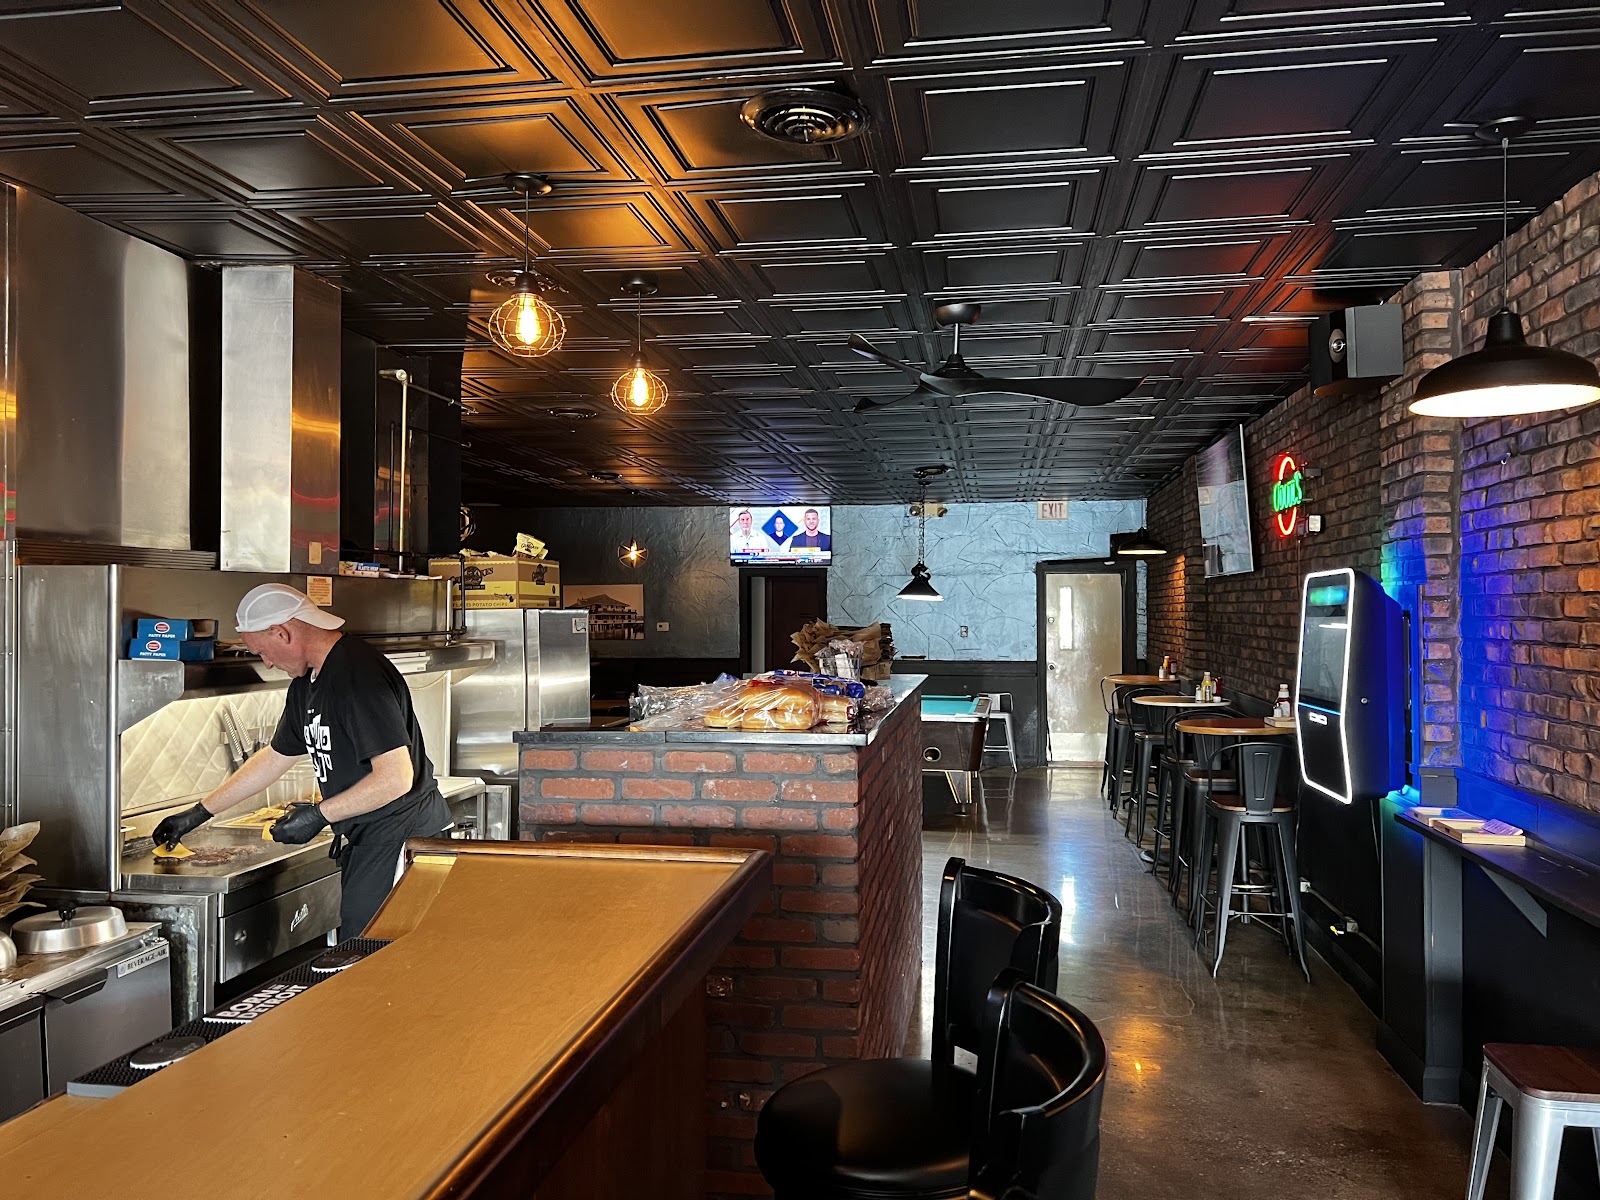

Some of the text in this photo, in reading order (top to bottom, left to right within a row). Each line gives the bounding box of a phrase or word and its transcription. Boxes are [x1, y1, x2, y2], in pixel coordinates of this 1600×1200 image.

[1041, 502, 1064, 519] EXIT
[216, 989, 281, 1018] BORN
[237, 984, 308, 1019] DETROIT
